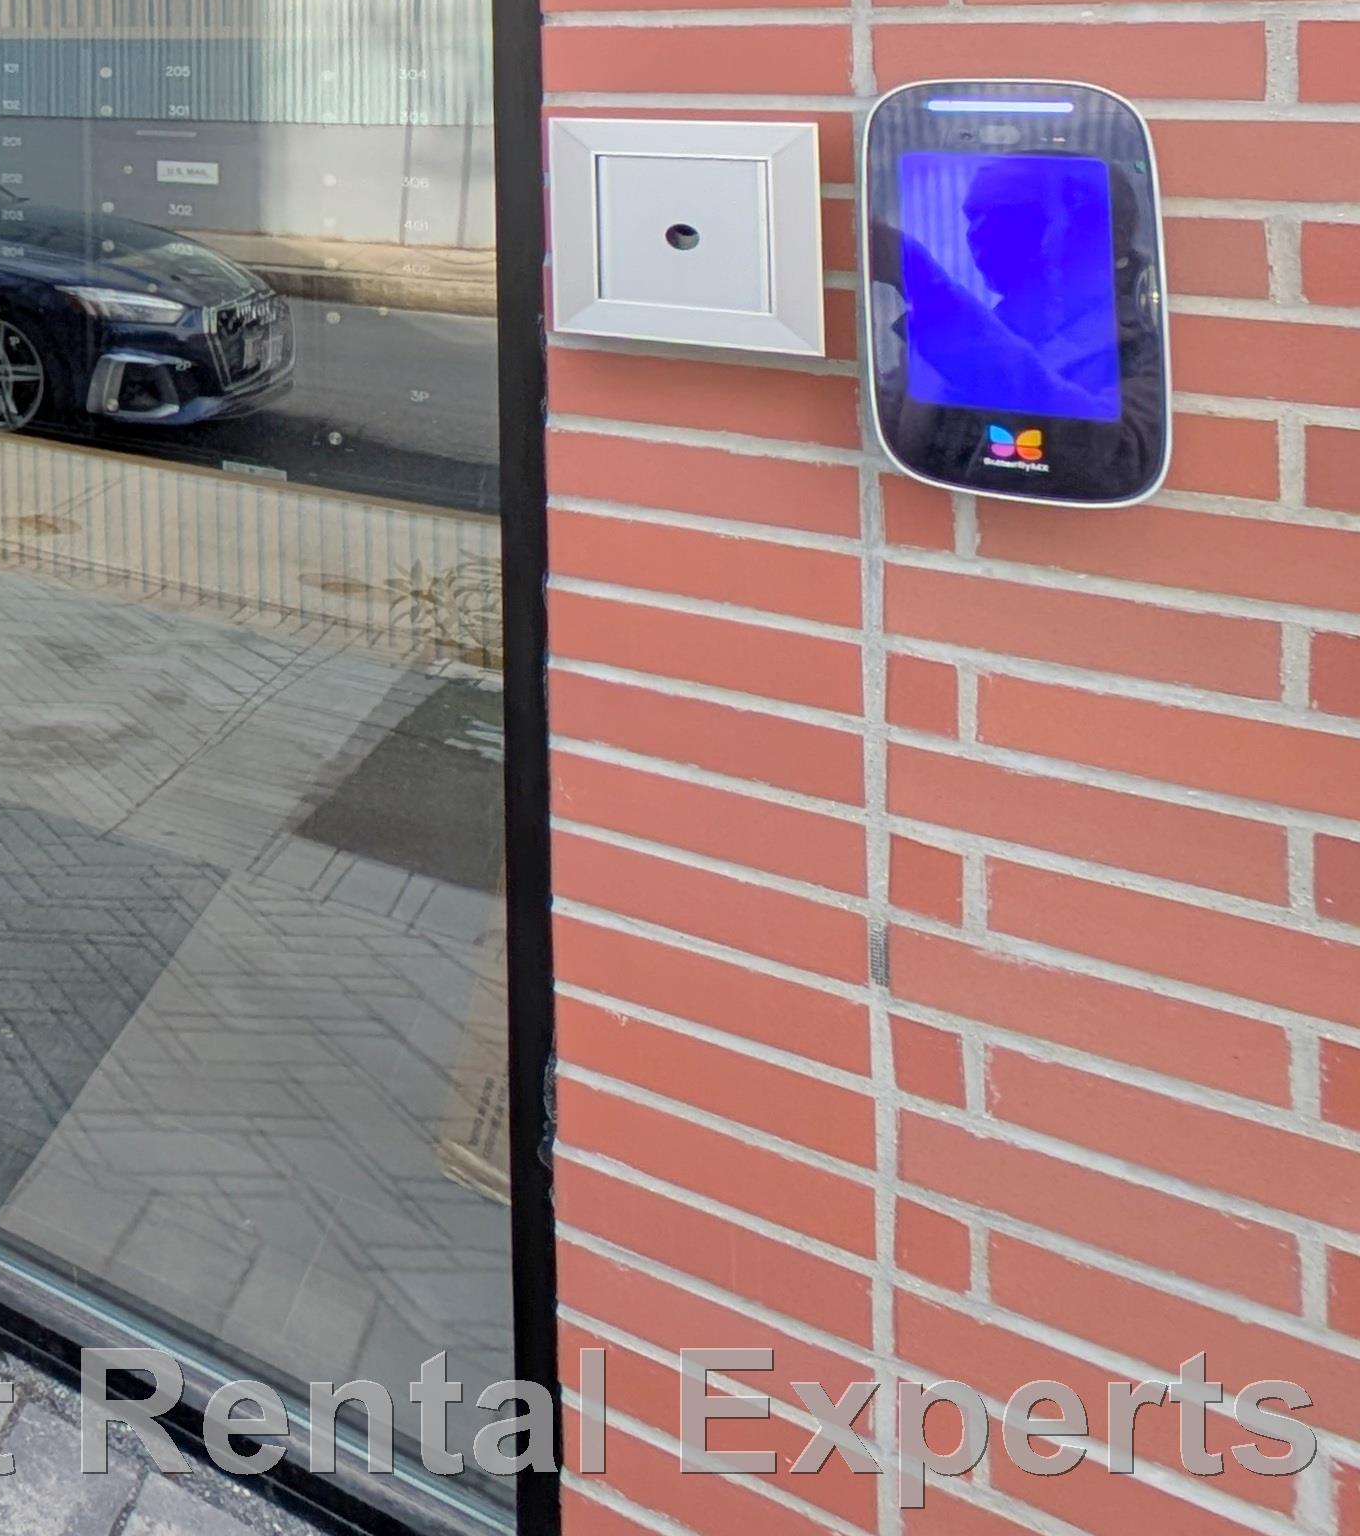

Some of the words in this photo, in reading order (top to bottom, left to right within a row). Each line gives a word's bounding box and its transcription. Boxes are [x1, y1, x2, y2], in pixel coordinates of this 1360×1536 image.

[165, 65, 191, 78] 205
[399, 68, 427, 81] 304
[168, 105, 190, 117] 301
[401, 176, 430, 189] 306
[1, 209, 24, 221] 203
[168, 203, 193, 216] 302
[404, 220, 429, 232] 401
[402, 263, 430, 275] 402
[410, 390, 430, 402] 3P
